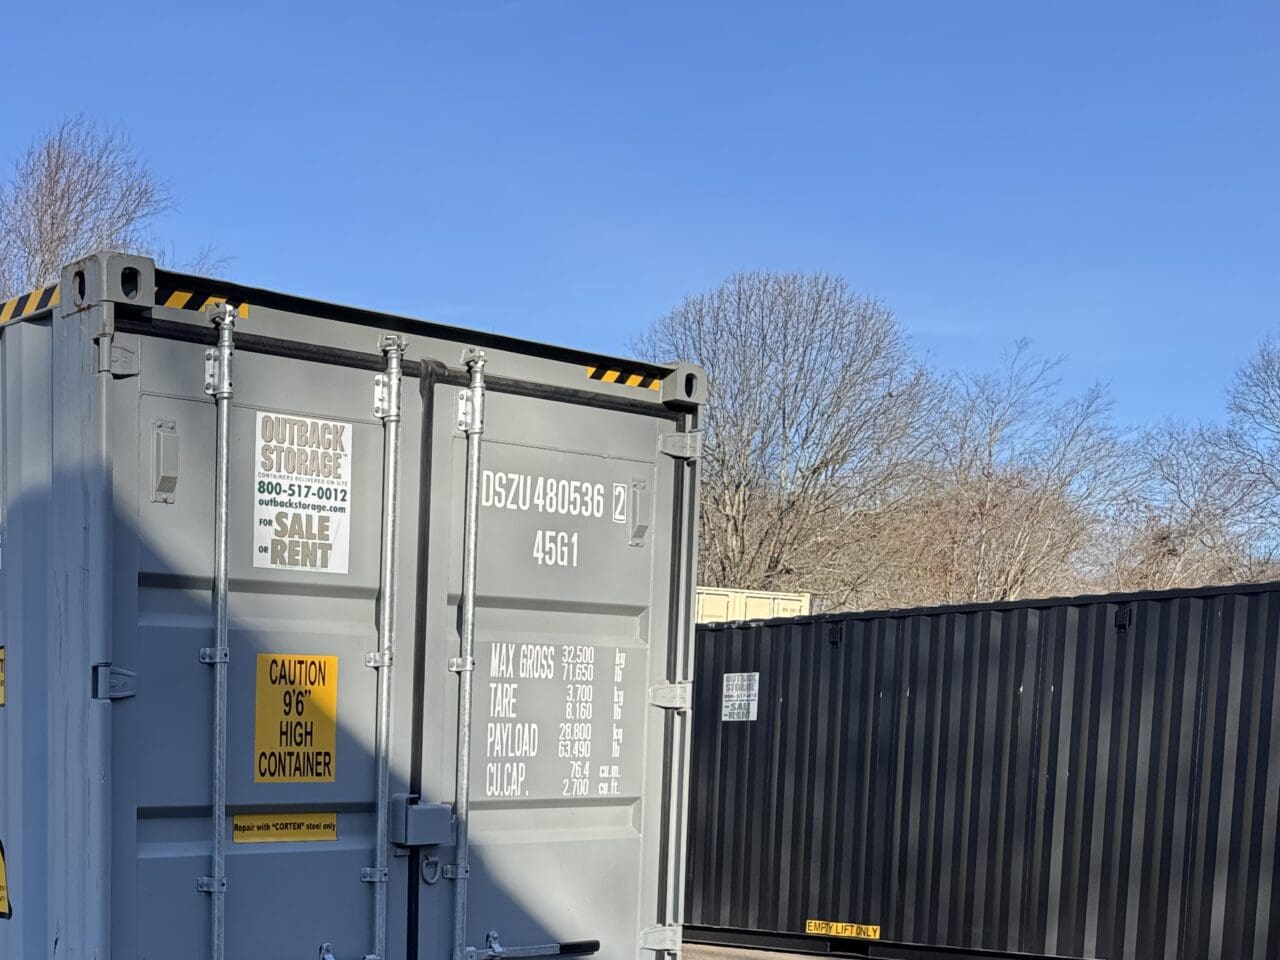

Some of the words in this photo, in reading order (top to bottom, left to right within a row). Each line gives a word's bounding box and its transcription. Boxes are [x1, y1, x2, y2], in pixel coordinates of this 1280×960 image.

[261, 414, 346, 452] OUTBACK
[260, 443, 343, 480] STORAGE
[257, 480, 348, 502] 800-517-0012
[258, 497, 347, 513] outbackstorage.com
[481, 470, 532, 510] DSZU
[533, 476, 605, 518] 480536
[614, 485, 626, 521] 2
[259, 518, 273, 527] FOR
[274, 511, 330, 541] SALE
[258, 545, 269, 554] OR
[270, 538, 333, 569] RENT
[532, 529, 579, 567] 45G1
[269, 659, 326, 686] CAUTION
[490, 643, 516, 678] MAX
[519, 644, 555, 680] GROSS
[562, 645, 595, 664] 32,500
[615, 648, 626, 668] kg
[614, 665, 623, 683] lb
[489, 682, 518, 718] TARE
[566, 684, 593, 703] 3,700
[613, 686, 624, 706] kg
[565, 702, 593, 721] 8,160
[613, 703, 621, 720] lb
[279, 720, 314, 748] HIGH
[486, 722, 539, 757] PAYLOAD
[612, 723, 623, 744] kg
[558, 740, 591, 758] 63,490
[611, 740, 620, 758] lb
[258, 751, 332, 778] CONTAINER
[486, 762, 529, 797] CU.CAP.
[570, 760, 590, 778] 76.4
[233, 823, 255, 834] Repair
[257, 823, 271, 832] with
[306, 822, 322, 831] steel
[323, 822, 336, 832] only
[807, 921, 833, 934] EMPTY
[835, 924, 855, 935] LIFT
[856, 926, 878, 937] ONLY
